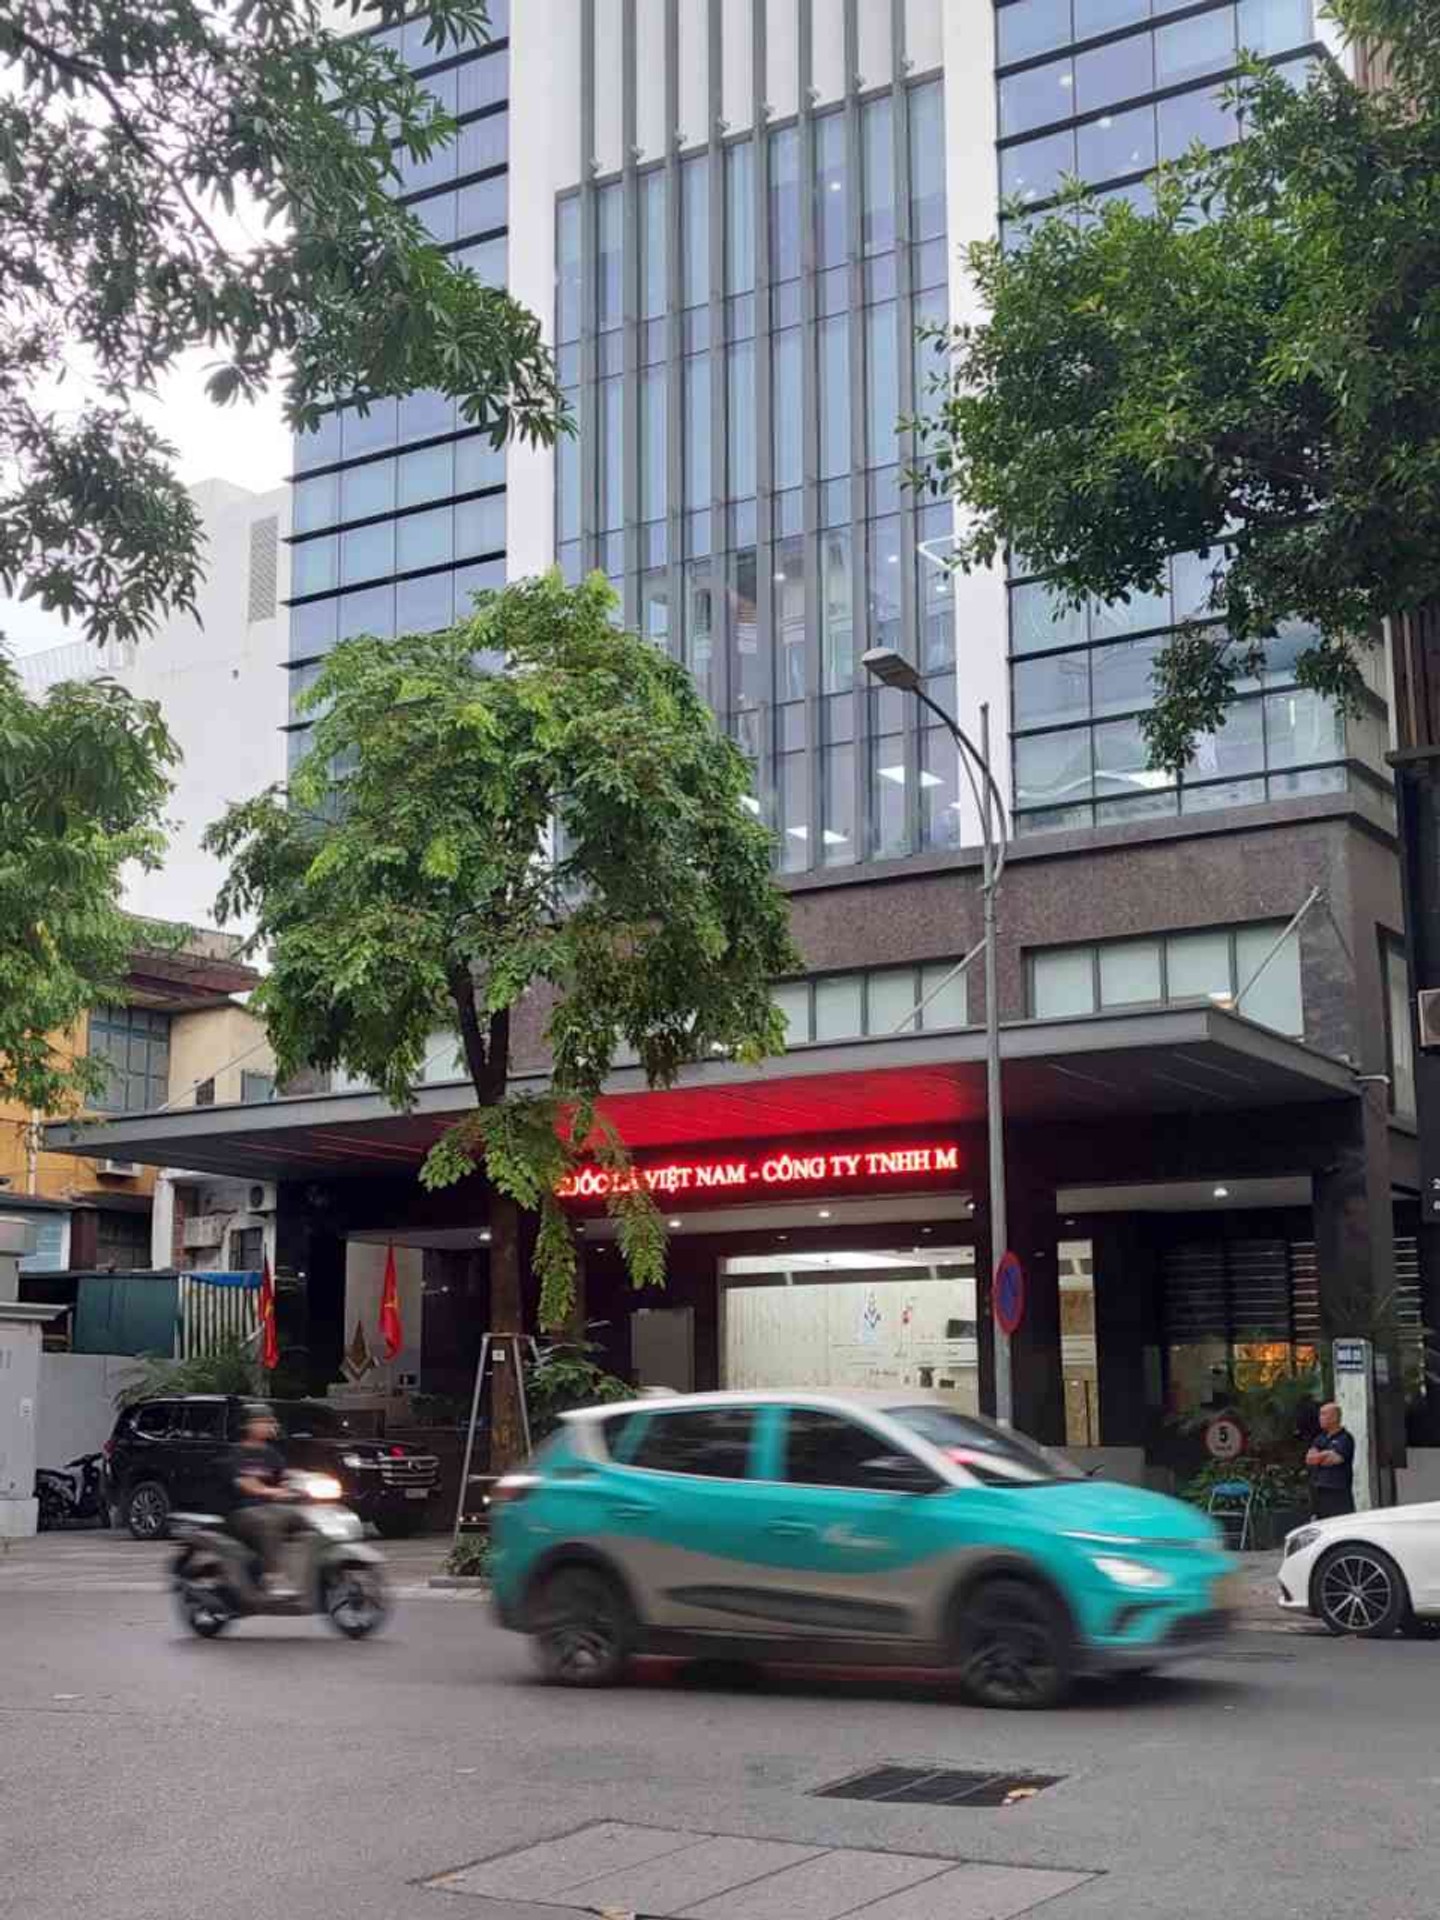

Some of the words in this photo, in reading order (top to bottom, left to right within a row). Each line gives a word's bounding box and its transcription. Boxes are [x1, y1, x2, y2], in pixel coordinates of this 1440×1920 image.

[644, 1165, 693, 1194] VIỆT
[694, 1163, 747, 1187] NAM
[749, 1171, 760, 1179] -
[762, 1153, 826, 1182] CÔNG
[830, 1153, 862, 1177] TY
[864, 1149, 931, 1174] TNHH
[933, 1147, 959, 1170] M
